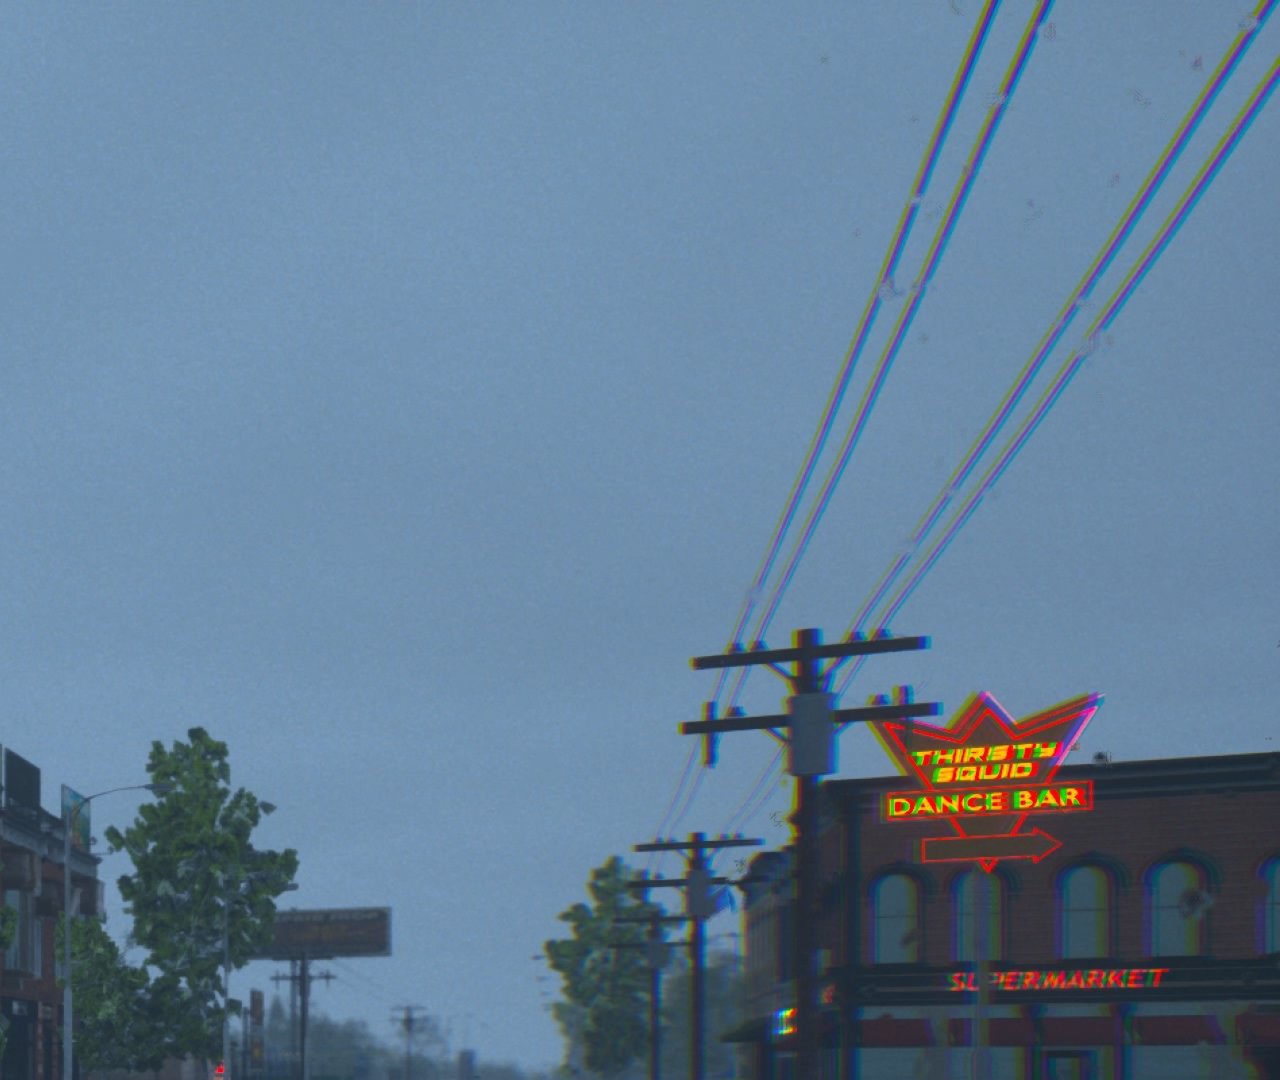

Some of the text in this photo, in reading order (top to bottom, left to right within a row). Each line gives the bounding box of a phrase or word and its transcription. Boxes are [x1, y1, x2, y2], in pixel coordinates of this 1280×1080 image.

[912, 743, 1062, 765] THIRSTY
[932, 762, 1040, 783] SQUID
[890, 788, 1085, 816] DANCE BAR
